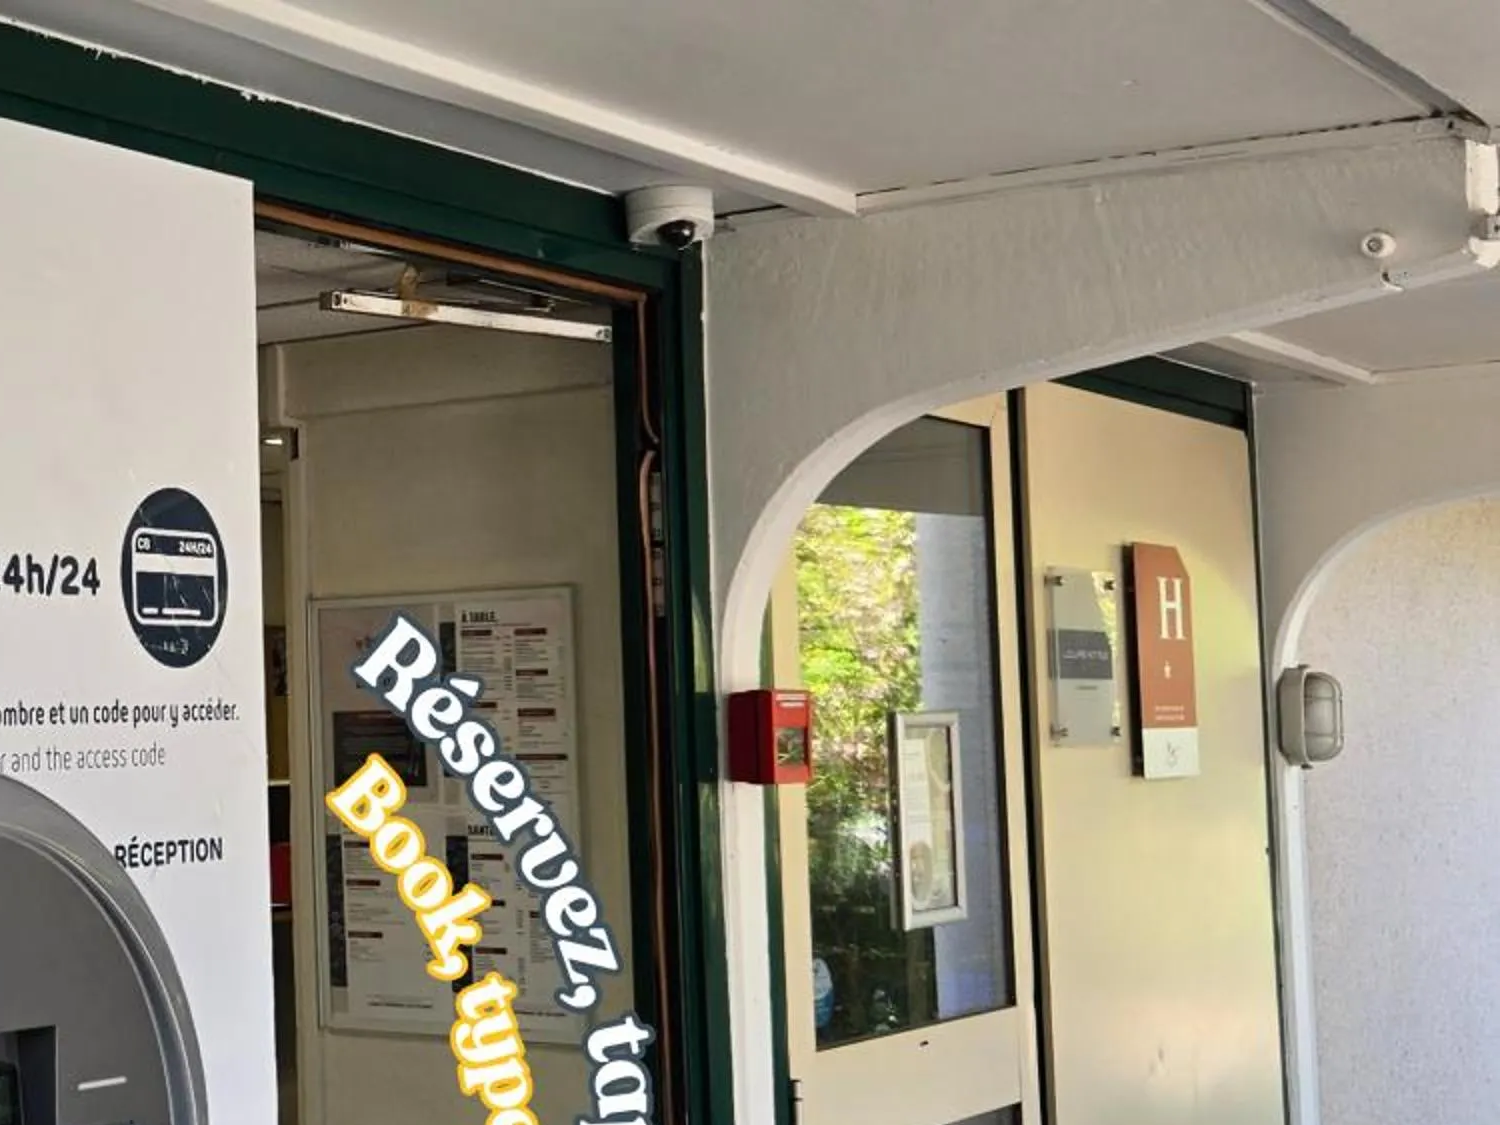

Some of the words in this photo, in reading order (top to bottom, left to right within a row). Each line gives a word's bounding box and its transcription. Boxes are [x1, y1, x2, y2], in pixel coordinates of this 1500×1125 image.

[1157, 577, 1186, 640] H
[49, 704, 66, 726] et
[69, 704, 89, 726] un
[93, 700, 129, 725] code
[133, 703, 166, 728] pour
[167, 702, 179, 729] y
[182, 700, 240, 723] accéder.
[11, 747, 41, 773] and
[46, 746, 71, 771] the
[77, 749, 127, 769] access
[131, 742, 166, 766] code
[115, 835, 223, 870] RÉCEPTION
